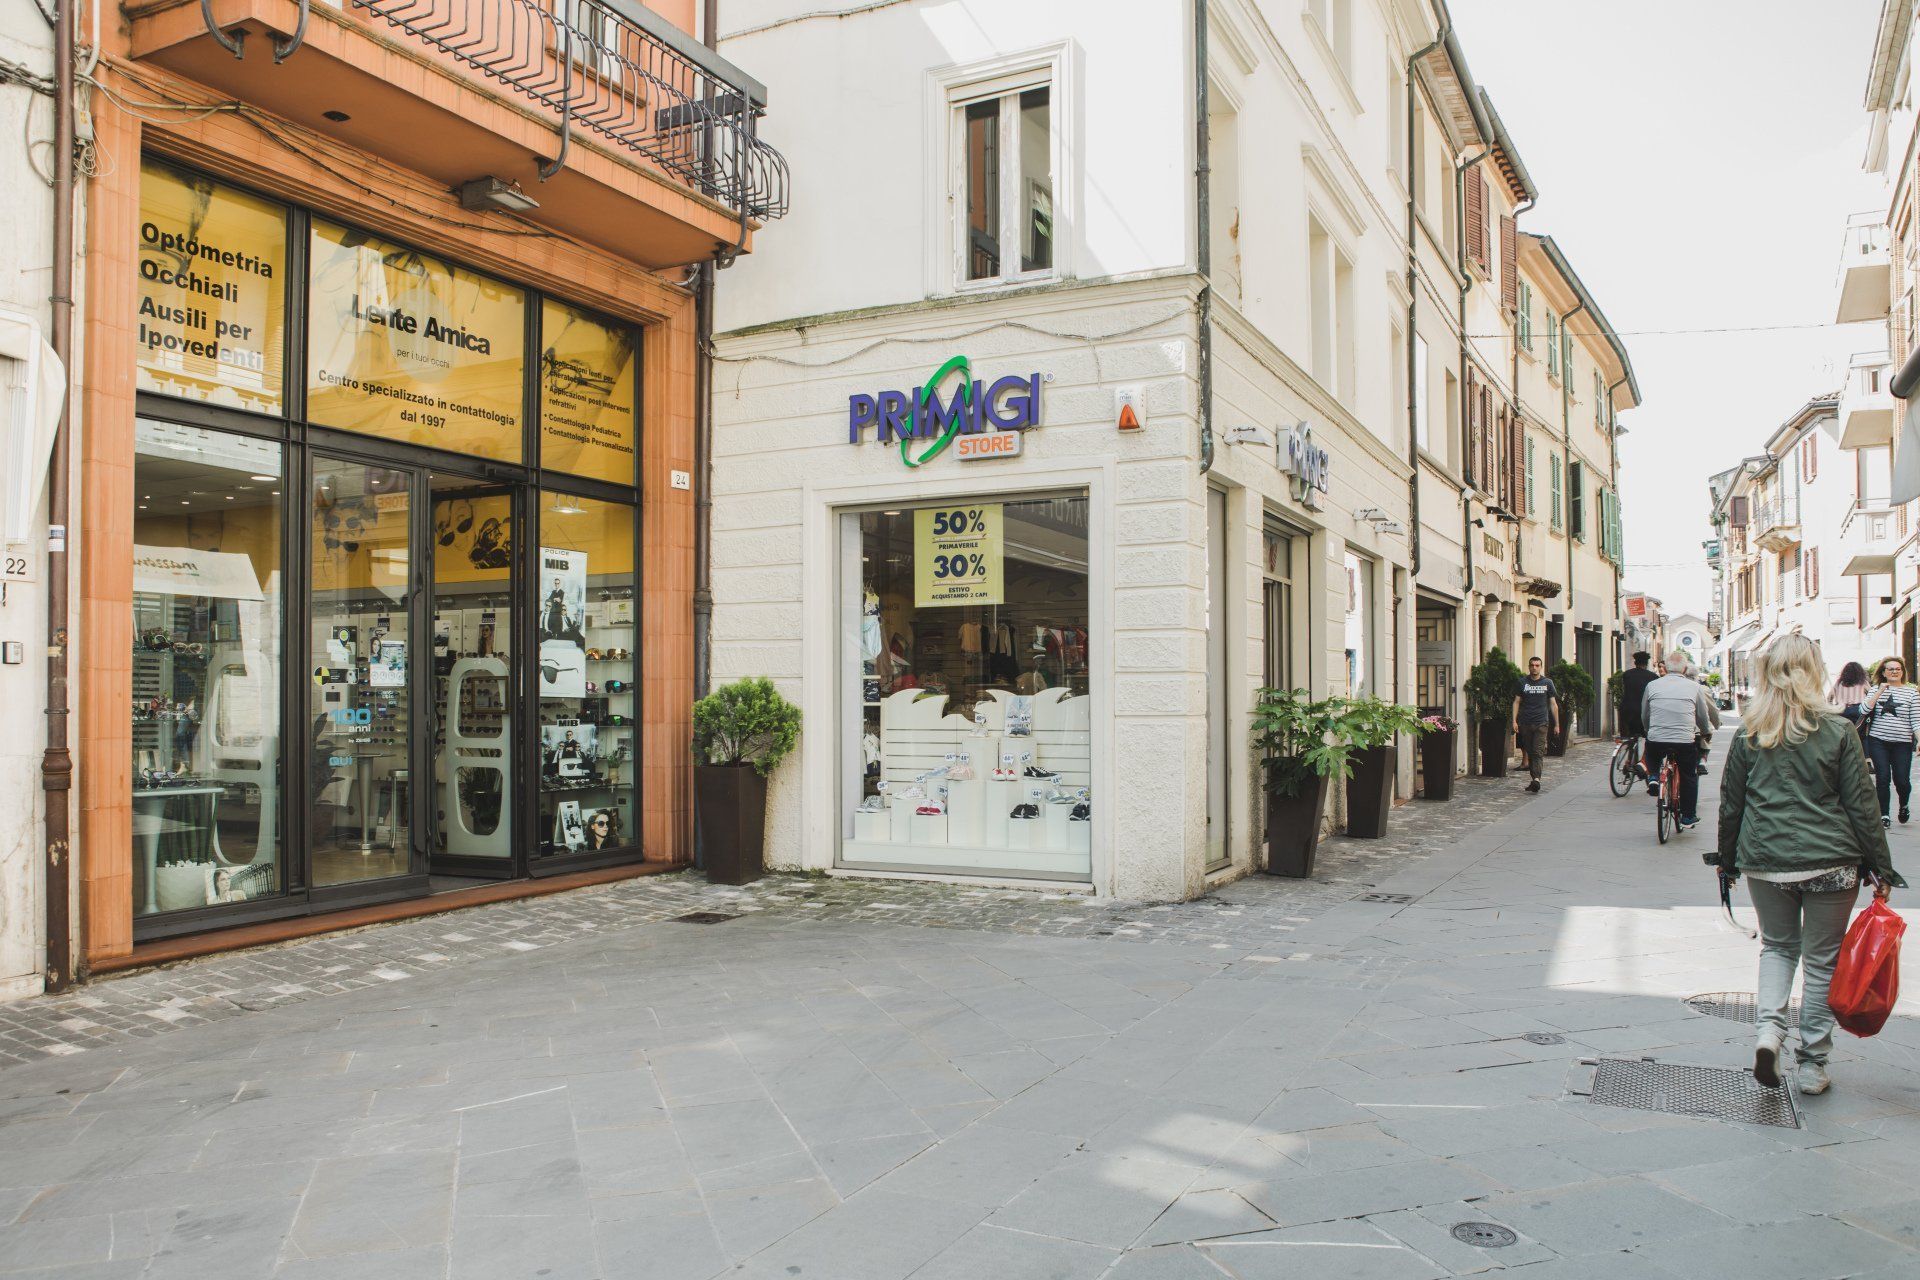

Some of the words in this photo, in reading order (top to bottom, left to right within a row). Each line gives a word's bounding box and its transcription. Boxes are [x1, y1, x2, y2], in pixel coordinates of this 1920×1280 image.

[141, 222, 274, 279] Optometria
[140, 259, 238, 303] Occhiali
[139, 296, 207, 331] Ausili
[215, 318, 252, 341] per
[351, 294, 417, 334] Lente
[423, 316, 491, 356] Amica
[139, 323, 262, 370] Ipovedenti
[396, 349, 409, 358] per
[416, 353, 430, 363] tuoi
[431, 358, 450, 368] occhi
[589, 369, 601, 379] lenti
[318, 370, 359, 390] Centro
[362, 381, 435, 407] specializzato
[437, 397, 447, 410] in
[450, 400, 515, 426] contattologia
[549, 385, 587, 402] Applicazioni
[588, 396, 602, 407] post
[603, 399, 631, 414] interventi
[549, 398, 577, 411] refrattivi
[849, 372, 1044, 445] PRIMIGI
[400, 410, 418, 424] dal
[421, 413, 446, 429] 1997
[549, 414, 591, 431] Contattologia
[592, 425, 622, 439] Pediatrica
[548, 427, 590, 444] Contattologia
[592, 438, 633, 454] Personalizzata
[958, 434, 1014, 456] STORE
[933, 509, 985, 536] 50%
[938, 542, 979, 550] PRIMAVERILE
[5, 557, 27, 576] 22
[545, 558, 570, 571] MIB
[933, 554, 986, 579] 30%
[329, 708, 372, 725] 100
[348, 724, 371, 733] anni
[558, 719, 579, 727] MIB
